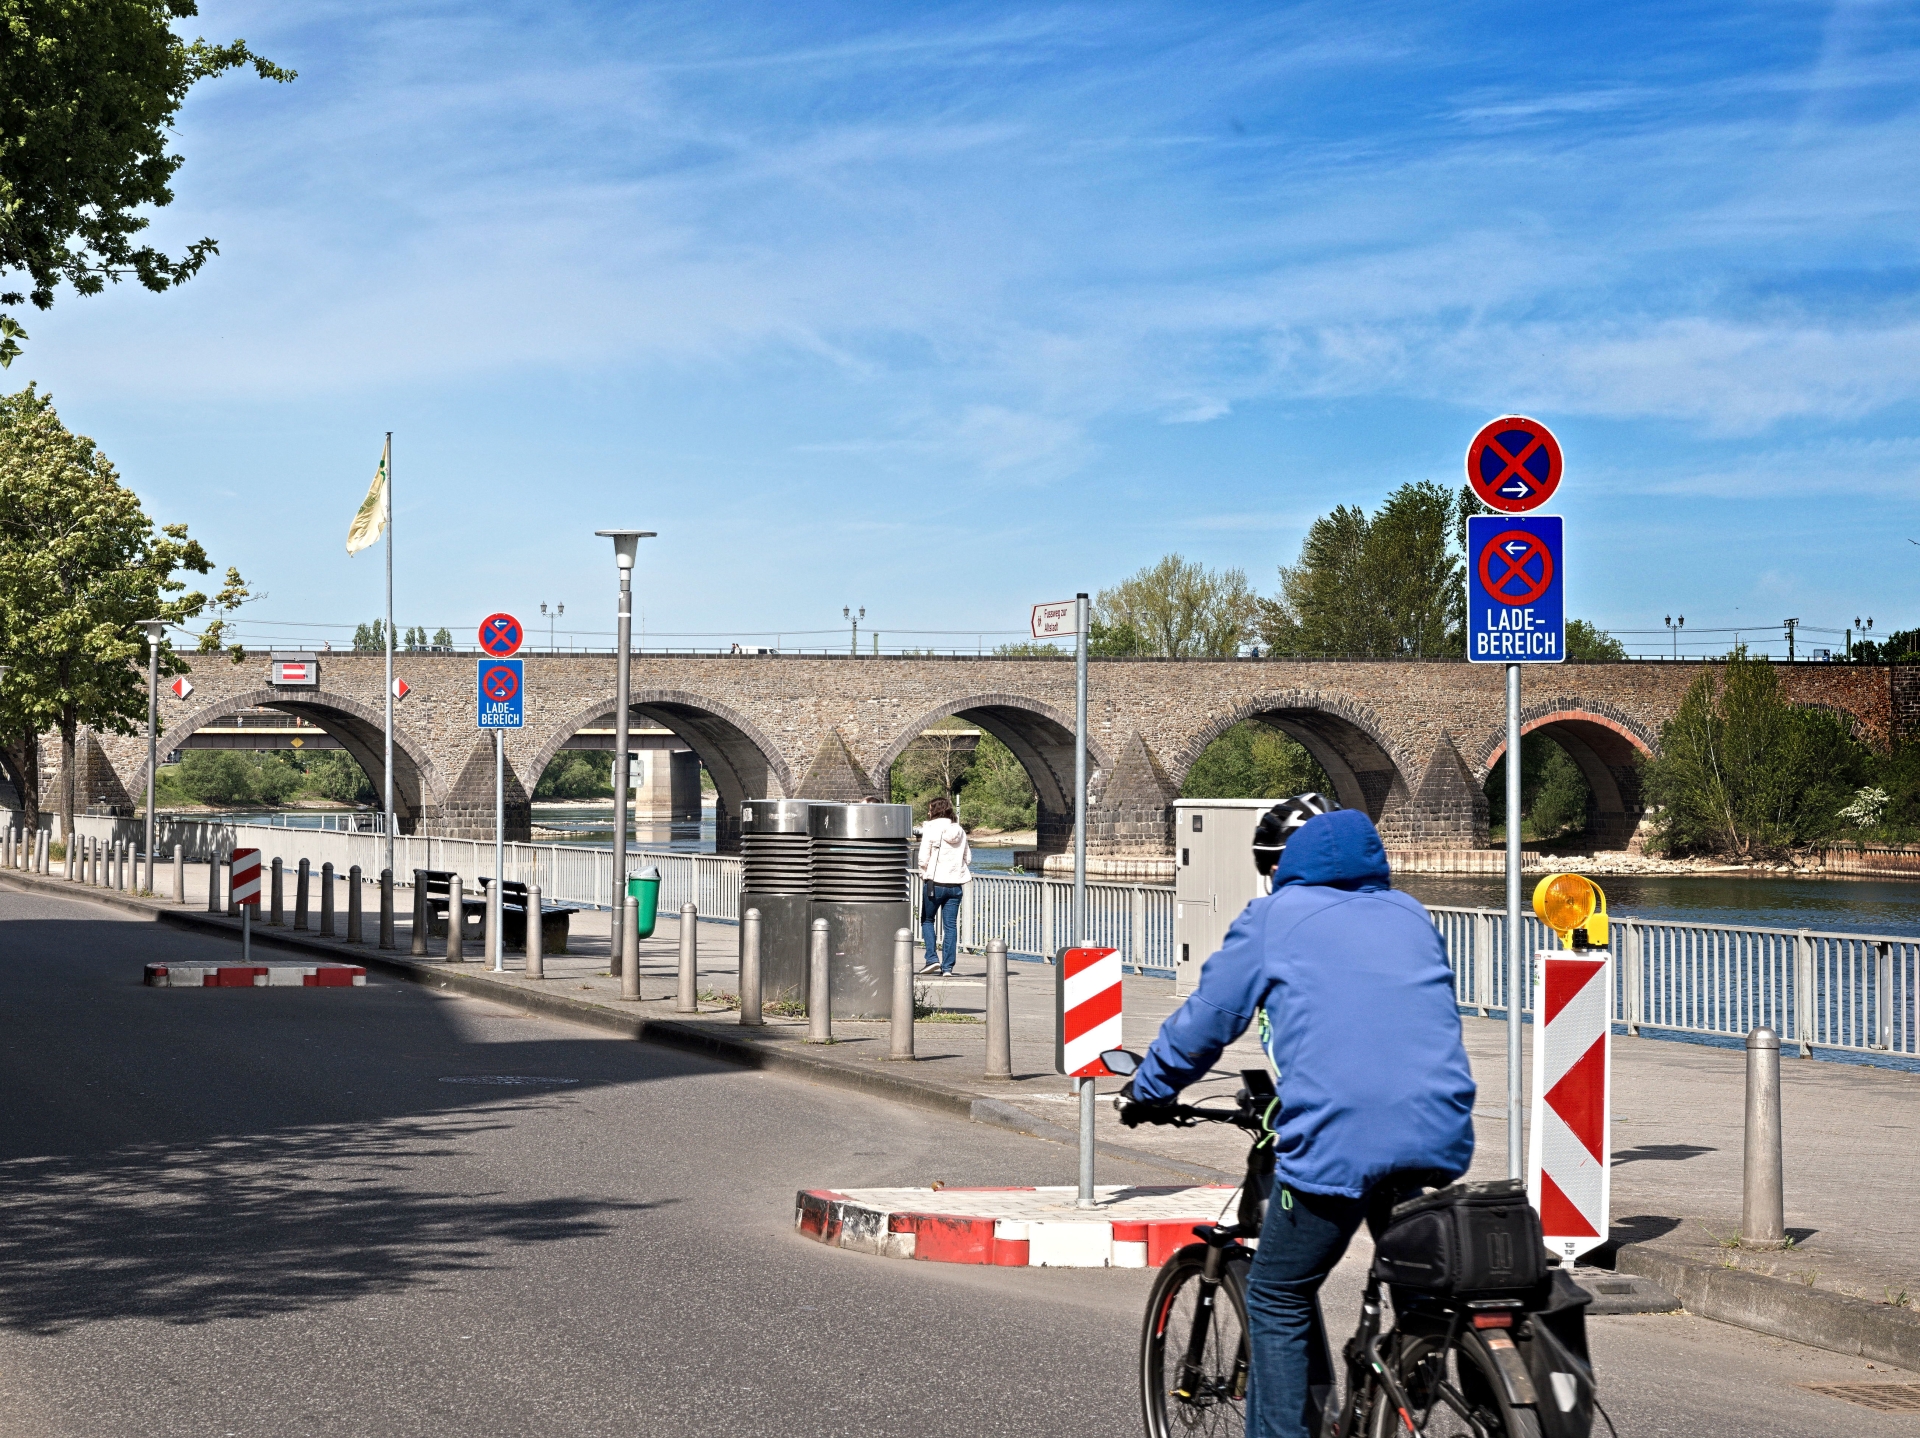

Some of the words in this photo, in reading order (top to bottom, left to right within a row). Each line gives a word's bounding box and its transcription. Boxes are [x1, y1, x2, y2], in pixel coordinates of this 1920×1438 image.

[1487, 608, 1546, 631] LADE-
[1044, 622, 1059, 632] Altstadt
[1477, 632, 1556, 655] BEREICH
[486, 702, 515, 714] LADE-
[481, 714, 520, 725] BEREICH
